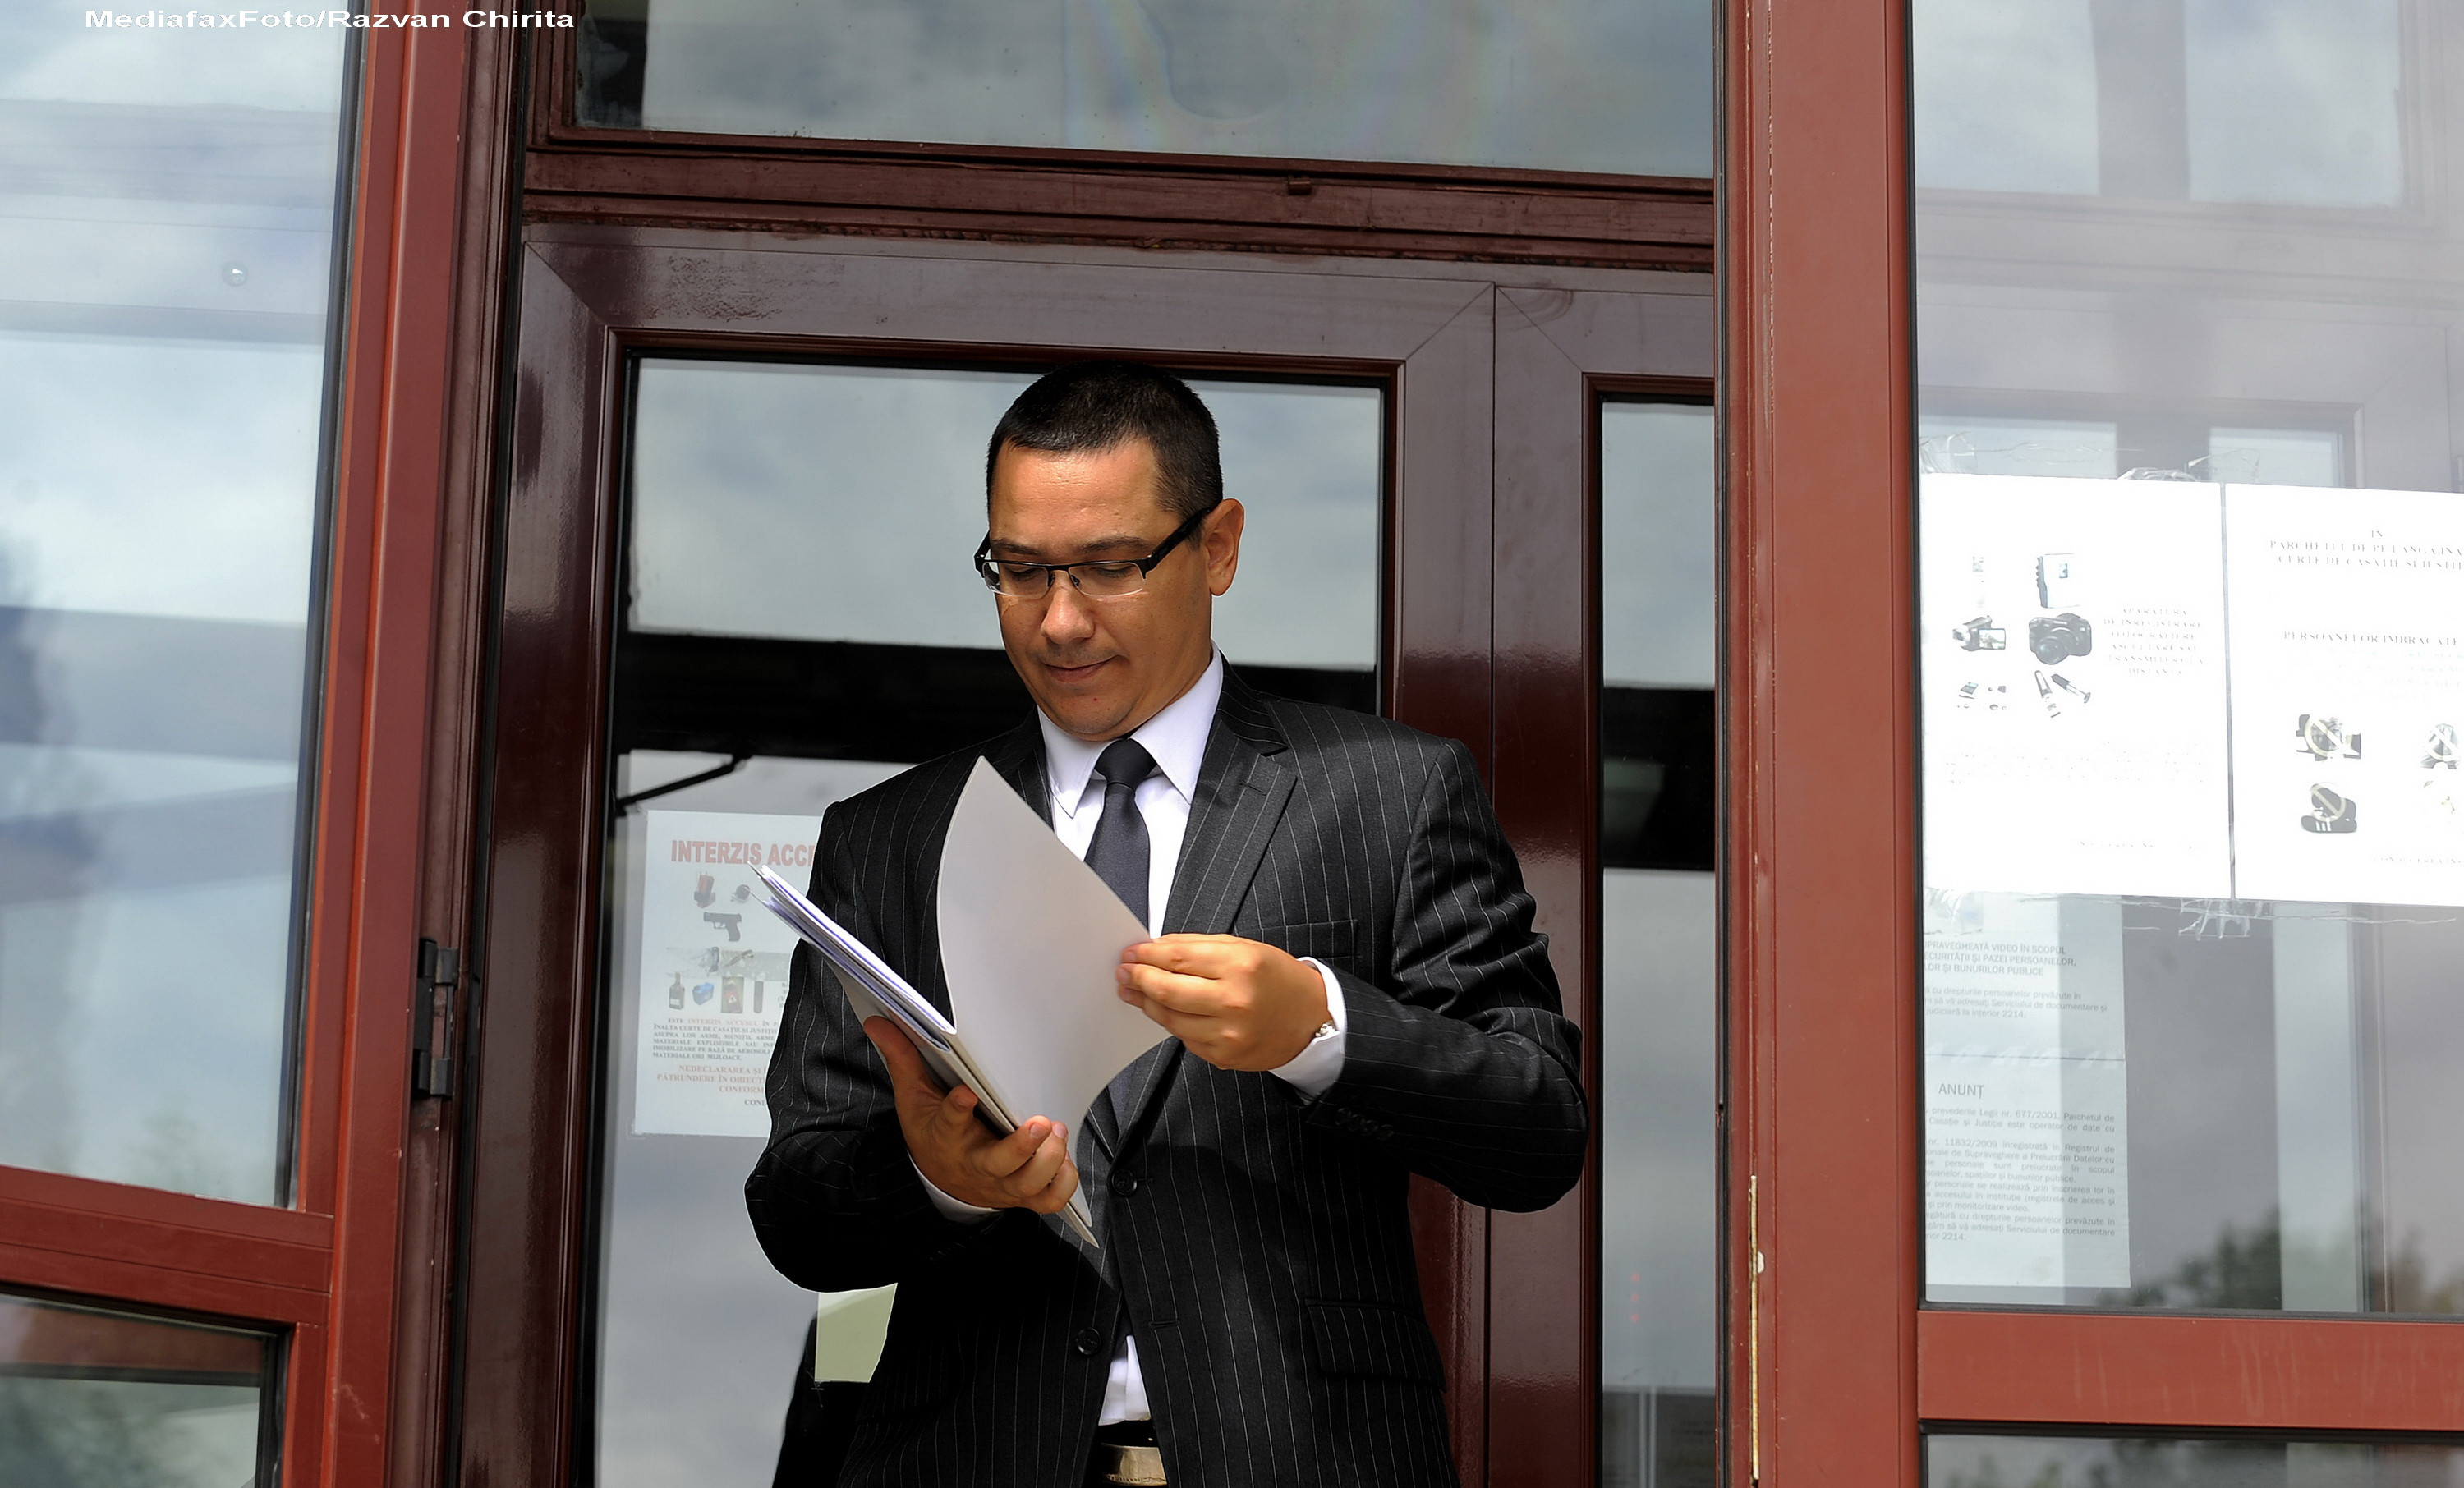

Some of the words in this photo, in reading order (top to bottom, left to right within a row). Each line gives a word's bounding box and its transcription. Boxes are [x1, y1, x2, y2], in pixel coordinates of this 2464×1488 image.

[671, 840, 762, 865] INTERZIS
[1992, 944, 2017, 953] VIDEO
[2032, 945, 2066, 954] SCOPUL
[1983, 954, 2007, 963] PAZEI
[2011, 955, 2076, 967] PERSOANELOR,
[1954, 964, 2005, 974] BUNURILOR
[2007, 967, 2044, 976] PUBLICE
[1944, 987, 1982, 998] drepturile
[1984, 988, 2030, 999] persoanelor
[2034, 1000, 2043, 1008] de
[2047, 1001, 2098, 1011] documentare
[1972, 1008, 2000, 1017] interior
[678, 1064, 751, 1074] NEDECLARAREA
[2063, 1112, 2102, 1122] Parchetul
[2104, 1114, 2114, 1122] de
[2007, 1119, 2025, 1128] este
[2030, 1120, 2063, 1132] operator
[2067, 1123, 2077, 1131] de
[2083, 1123, 2100, 1132] date
[2065, 1143, 2100, 1154] Registrul
[2104, 1145, 2114, 1153] de
[1951, 1149, 1961, 1157] de
[1965, 1149, 2020, 1161] Supraveghere
[2073, 1155, 2103, 1164] Datelor
[1945, 1158, 1984, 1169] personale
[1994, 1160, 2011, 1169] sunt
[2021, 1162, 2062, 1173] prelucrate
[2089, 1165, 2114, 1175] scopul
[2007, 1172, 2043, 1181] bunurilor
[2045, 1173, 2076, 1184] publice.
[2033, 1183, 2048, 1193] prin
[2094, 1186, 2103, 1194] lor
[2068, 1195, 2078, 1203] de
[1937, 1201, 1952, 1210] prin
[1955, 1201, 2004, 1210] monitorizare
[2006, 1203, 2030, 1211] video.
[1973, 1212, 2011, 1223] drepturile
[2014, 1214, 2062, 1224] persoanelor
[2050, 1226, 2060, 1234] de
[2062, 1227, 2115, 1237] documentare
